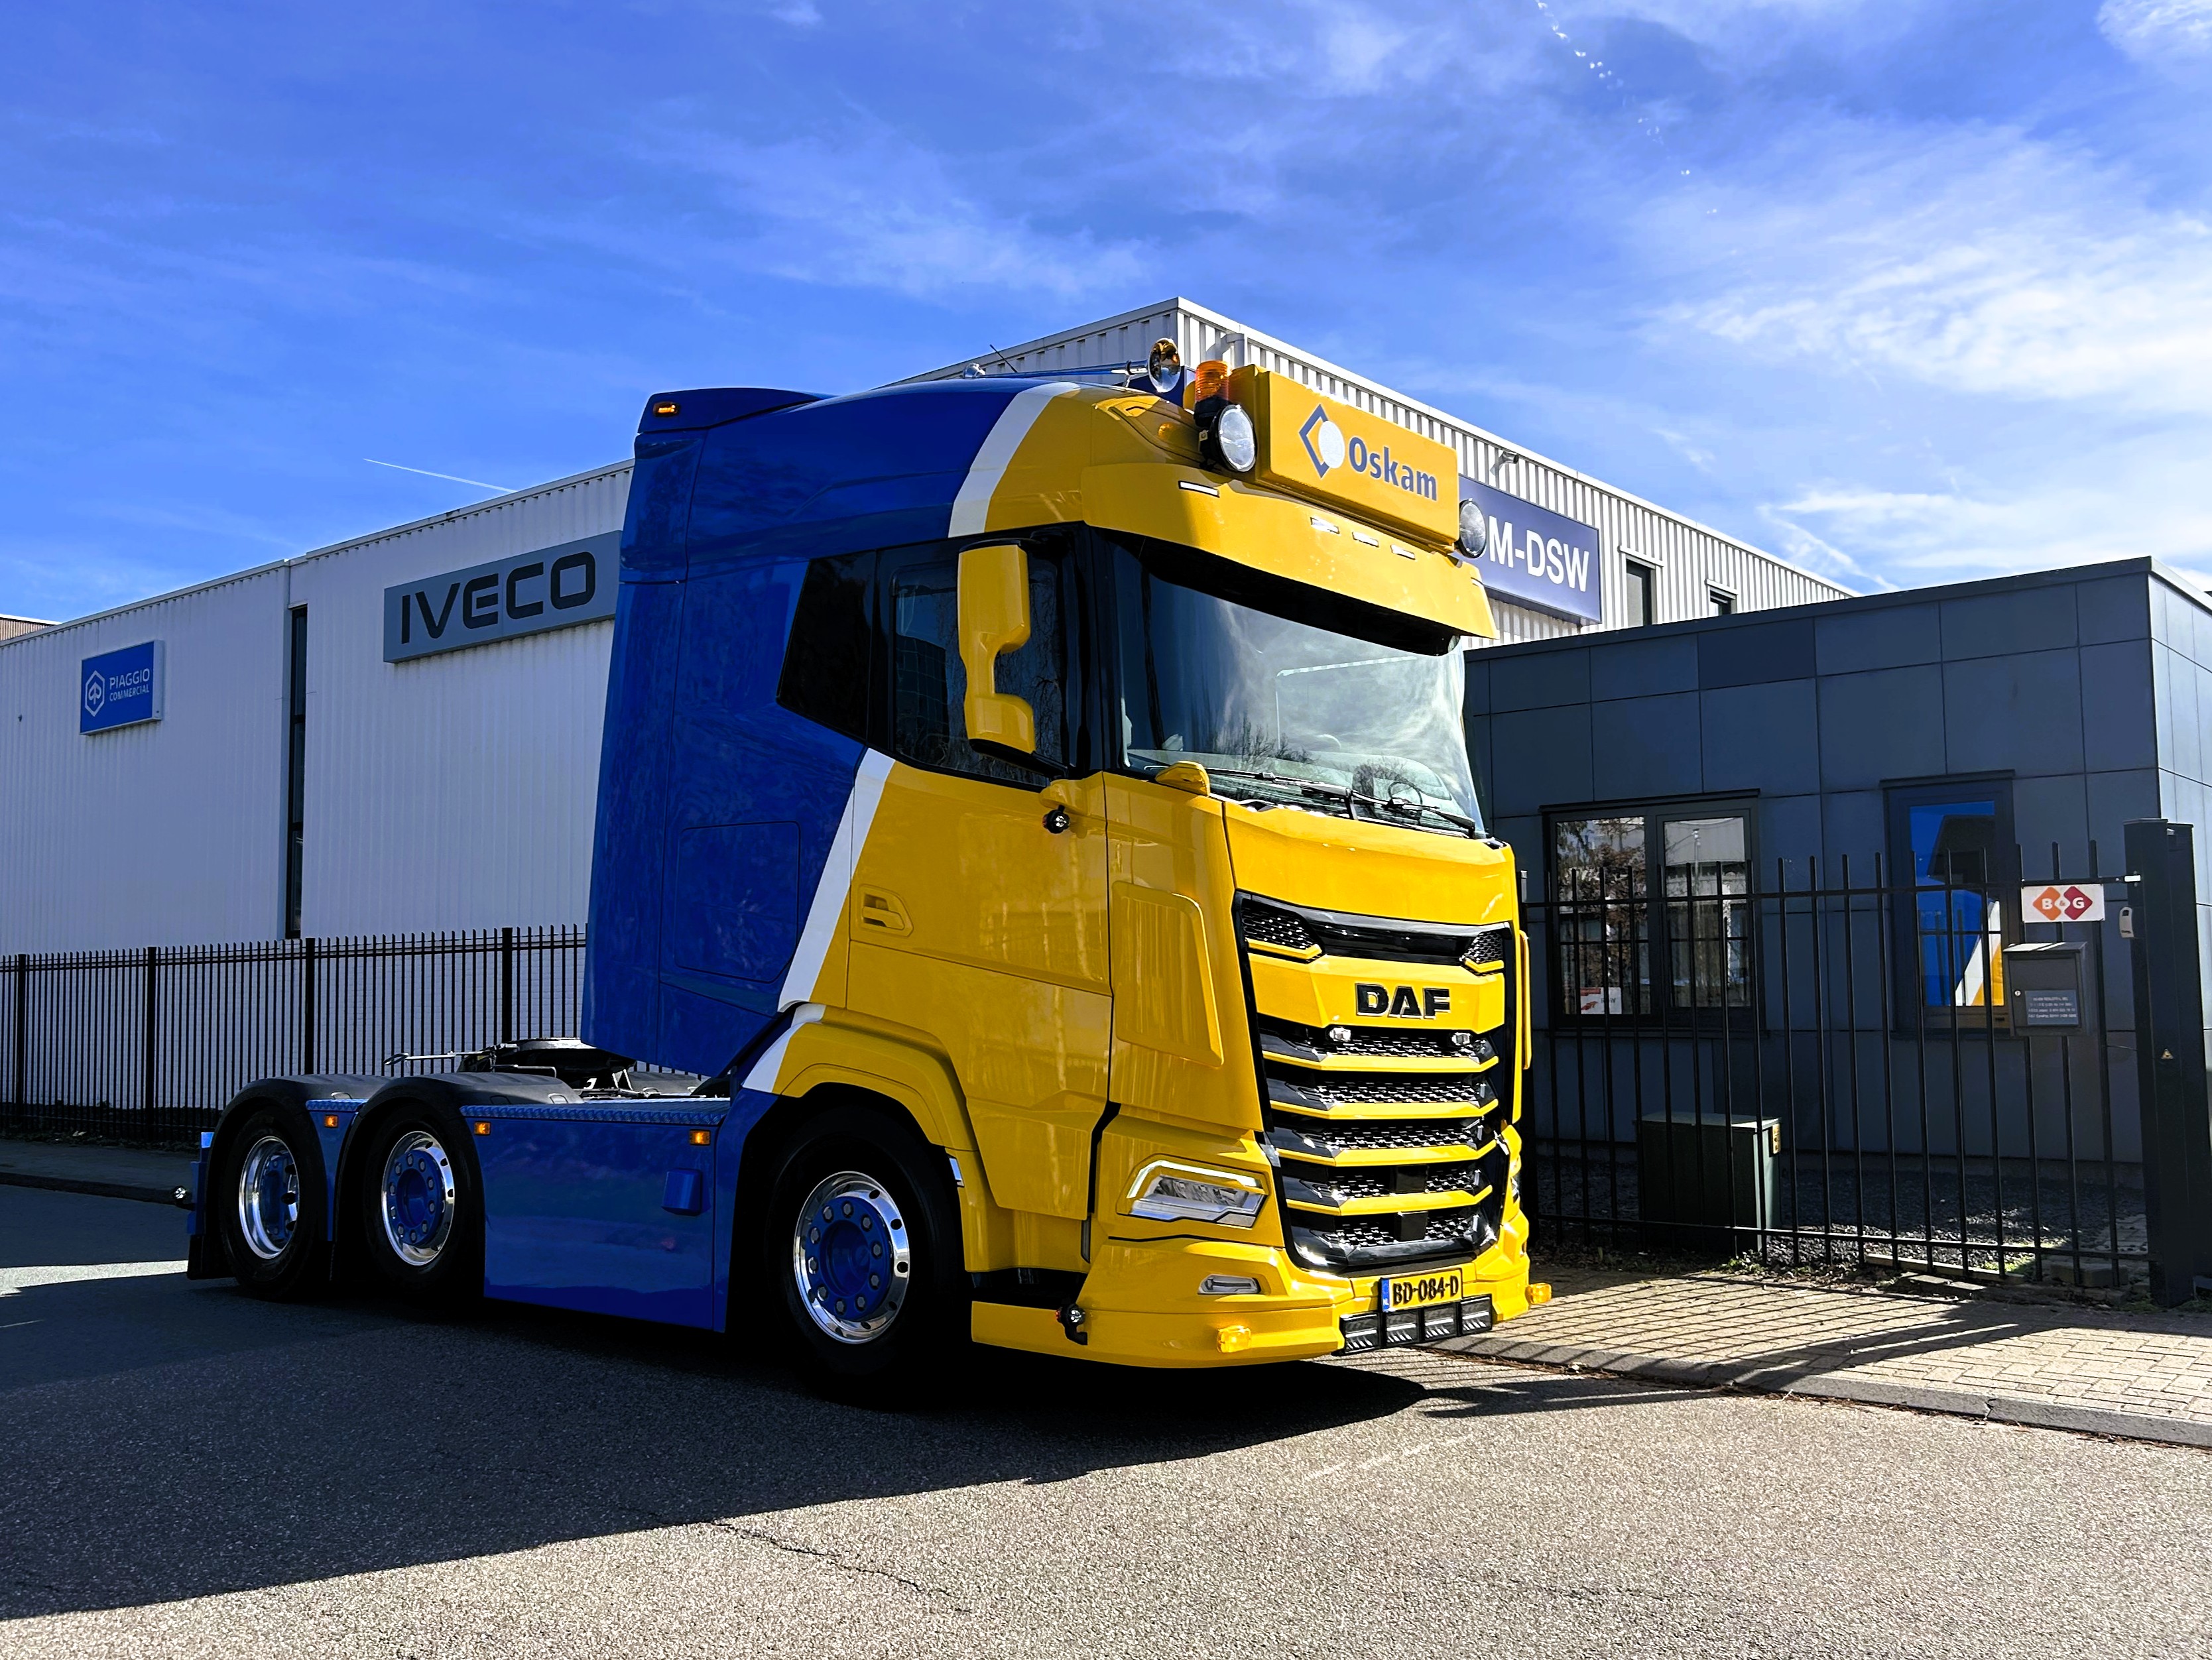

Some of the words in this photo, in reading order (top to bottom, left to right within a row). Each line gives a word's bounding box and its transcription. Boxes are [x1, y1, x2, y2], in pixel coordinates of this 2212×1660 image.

[1349, 436, 1438, 501] Oskam
[1480, 515, 1589, 592] M-DSW
[401, 552, 596, 644] IVECO
[109, 668, 150, 689] PIAGGIO
[109, 684, 149, 701] COMMERCIAL
[1355, 983, 1451, 1019] DAF
[1392, 1275, 1459, 1306] BD-084-D
